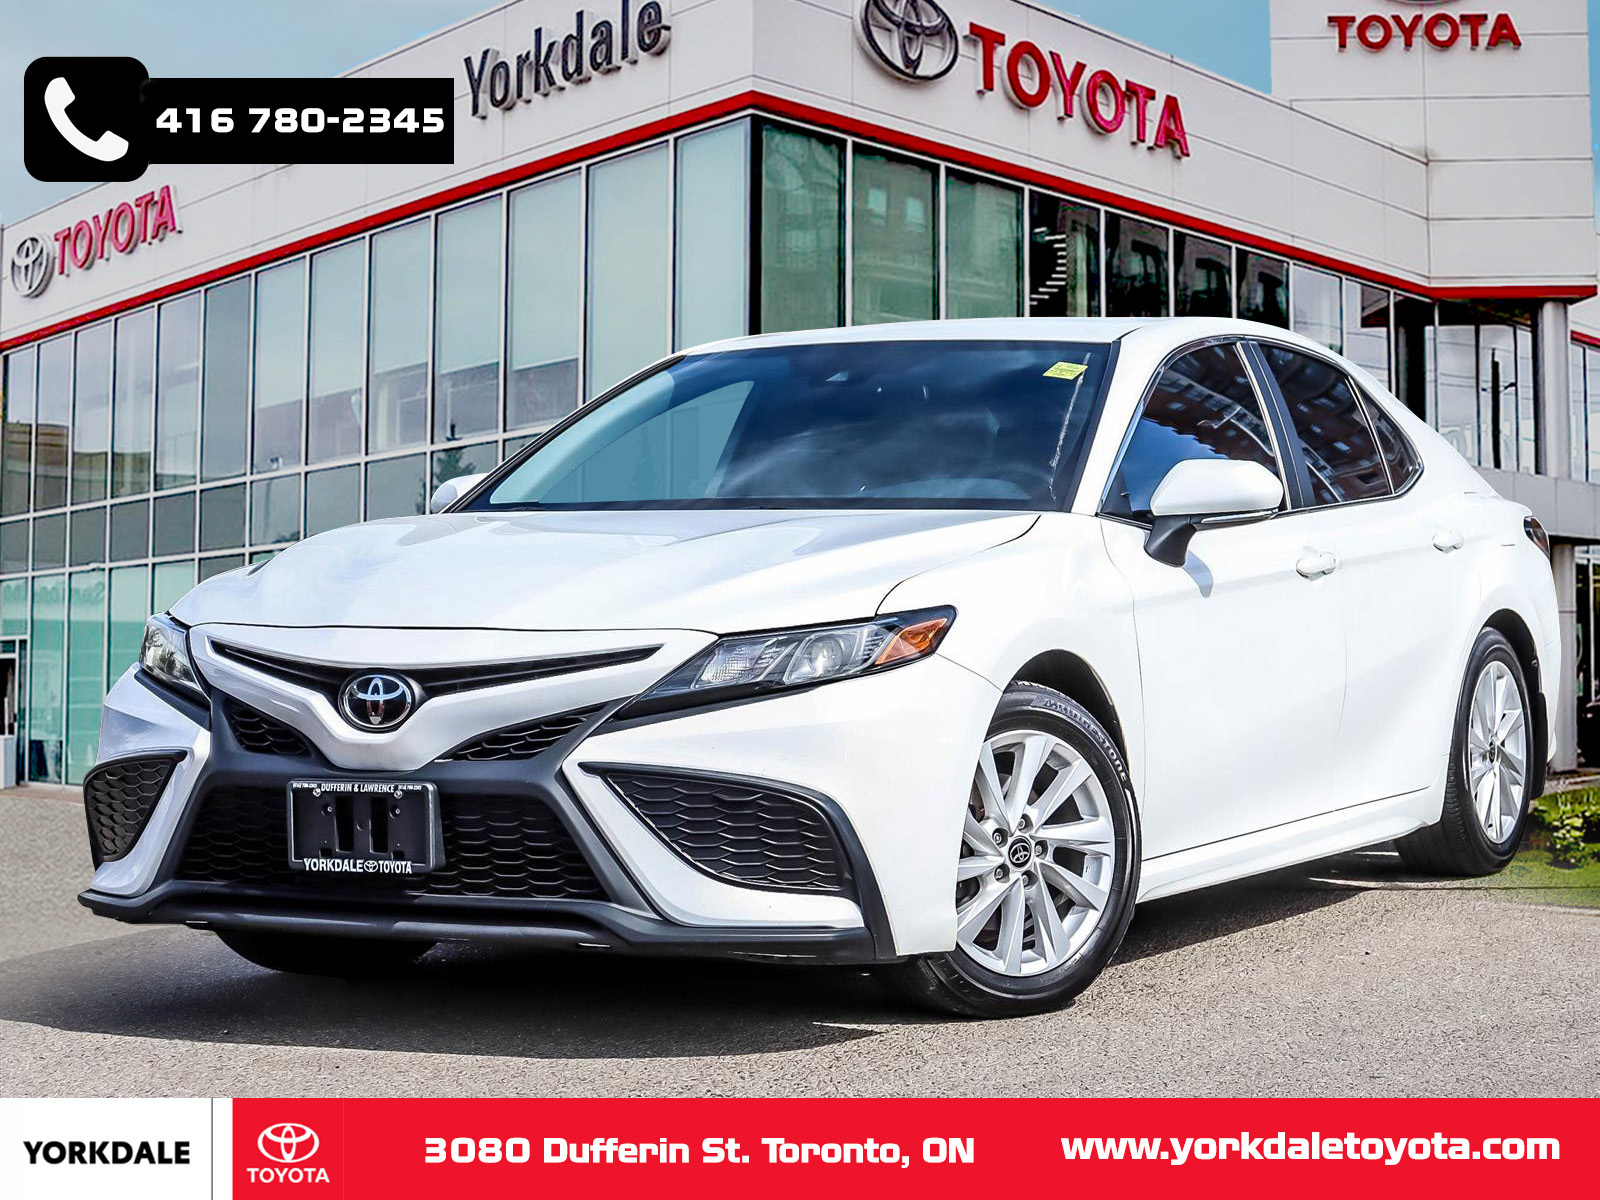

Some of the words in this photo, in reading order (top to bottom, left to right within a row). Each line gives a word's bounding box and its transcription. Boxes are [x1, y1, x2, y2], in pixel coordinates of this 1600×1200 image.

[464, 0, 671, 118] Yorkdale
[1327, 13, 1521, 50] TOYOTA
[966, 21, 1190, 159] TOYOTA
[54, 185, 179, 276] TOYOTA
[320, 783, 353, 792] DUFFERIN
[353, 783, 359, 792] &
[360, 783, 395, 793] LAWRENCE
[303, 857, 364, 873] YORKDALE
[378, 860, 412, 874] TOYOTA
